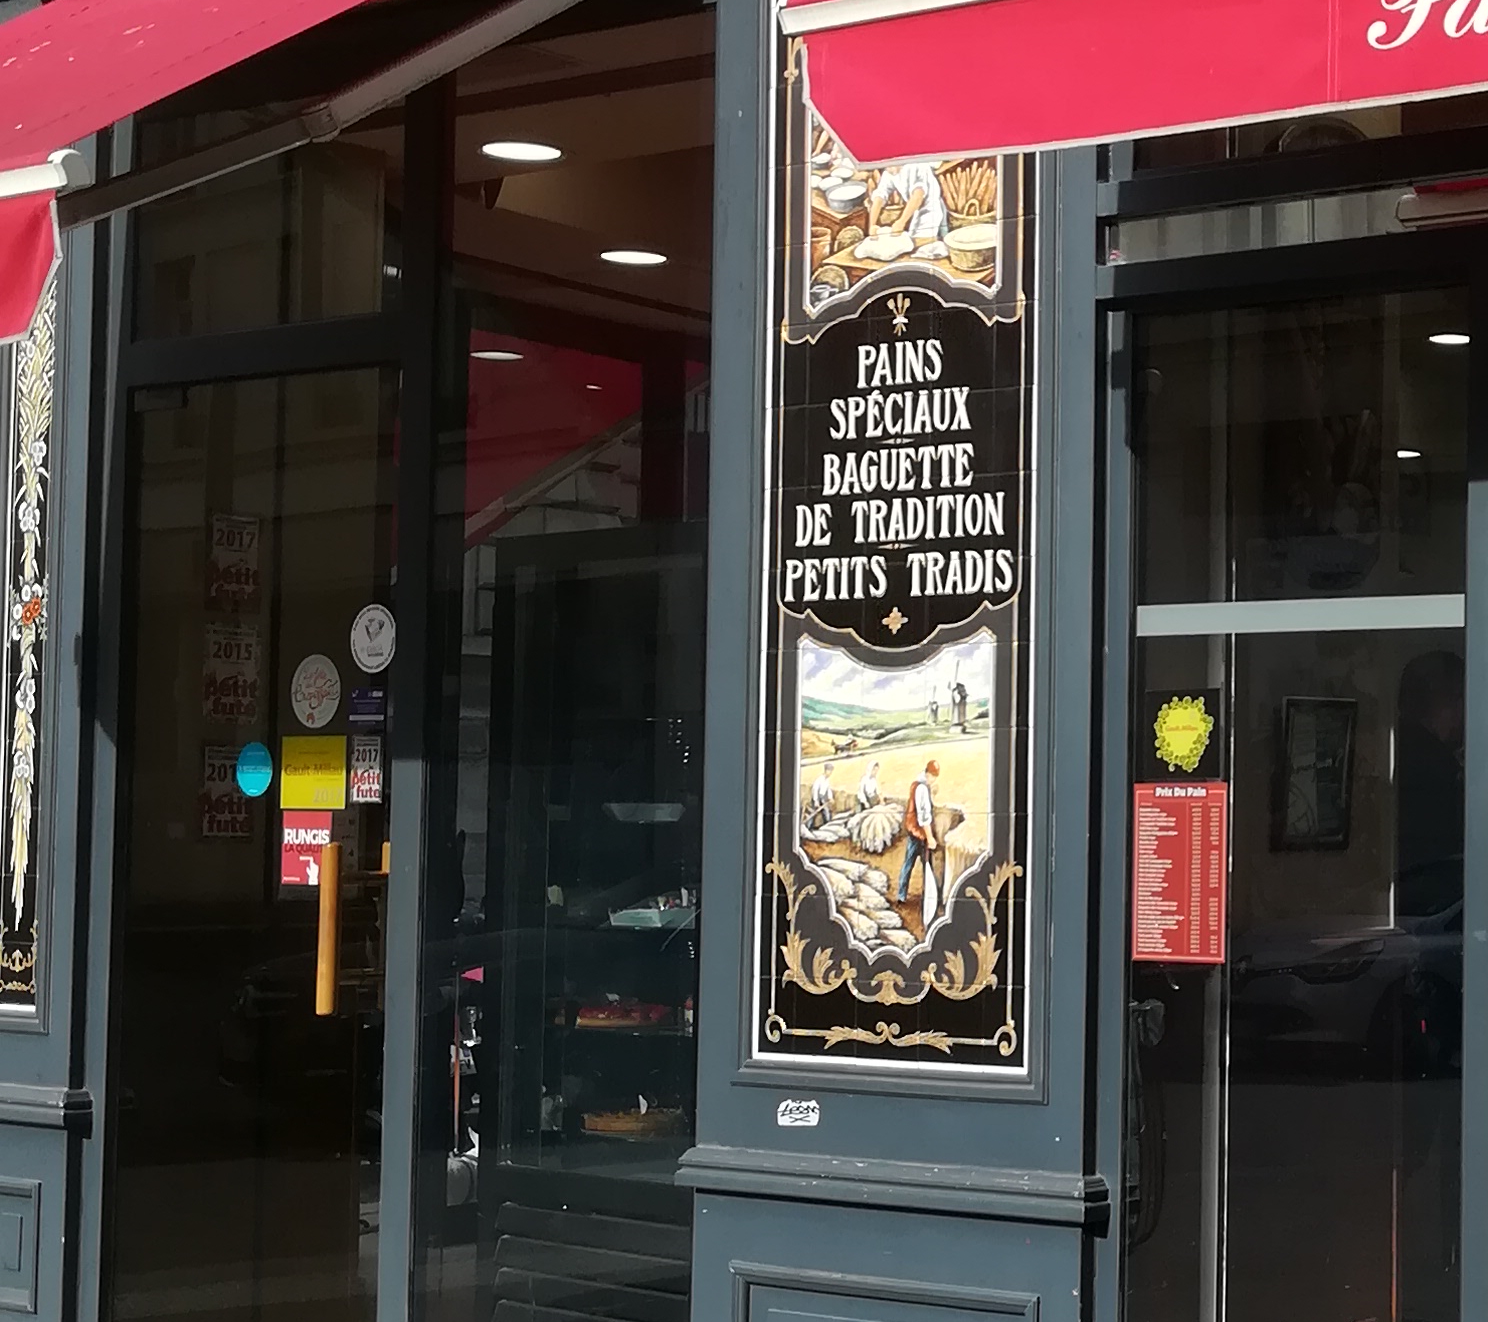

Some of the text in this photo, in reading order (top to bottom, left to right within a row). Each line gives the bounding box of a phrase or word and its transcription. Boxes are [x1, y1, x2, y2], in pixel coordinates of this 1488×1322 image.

[857, 339, 944, 389] PAINS
[829, 386, 972, 440] SPÉCIAUX
[822, 443, 974, 496] BAGUETTE
[795, 492, 1006, 547] DE TRADITION
[784, 549, 1014, 602] PETITS TRADIS
[355, 748, 379, 763] 2017
[284, 829, 331, 845] RUNGIS
